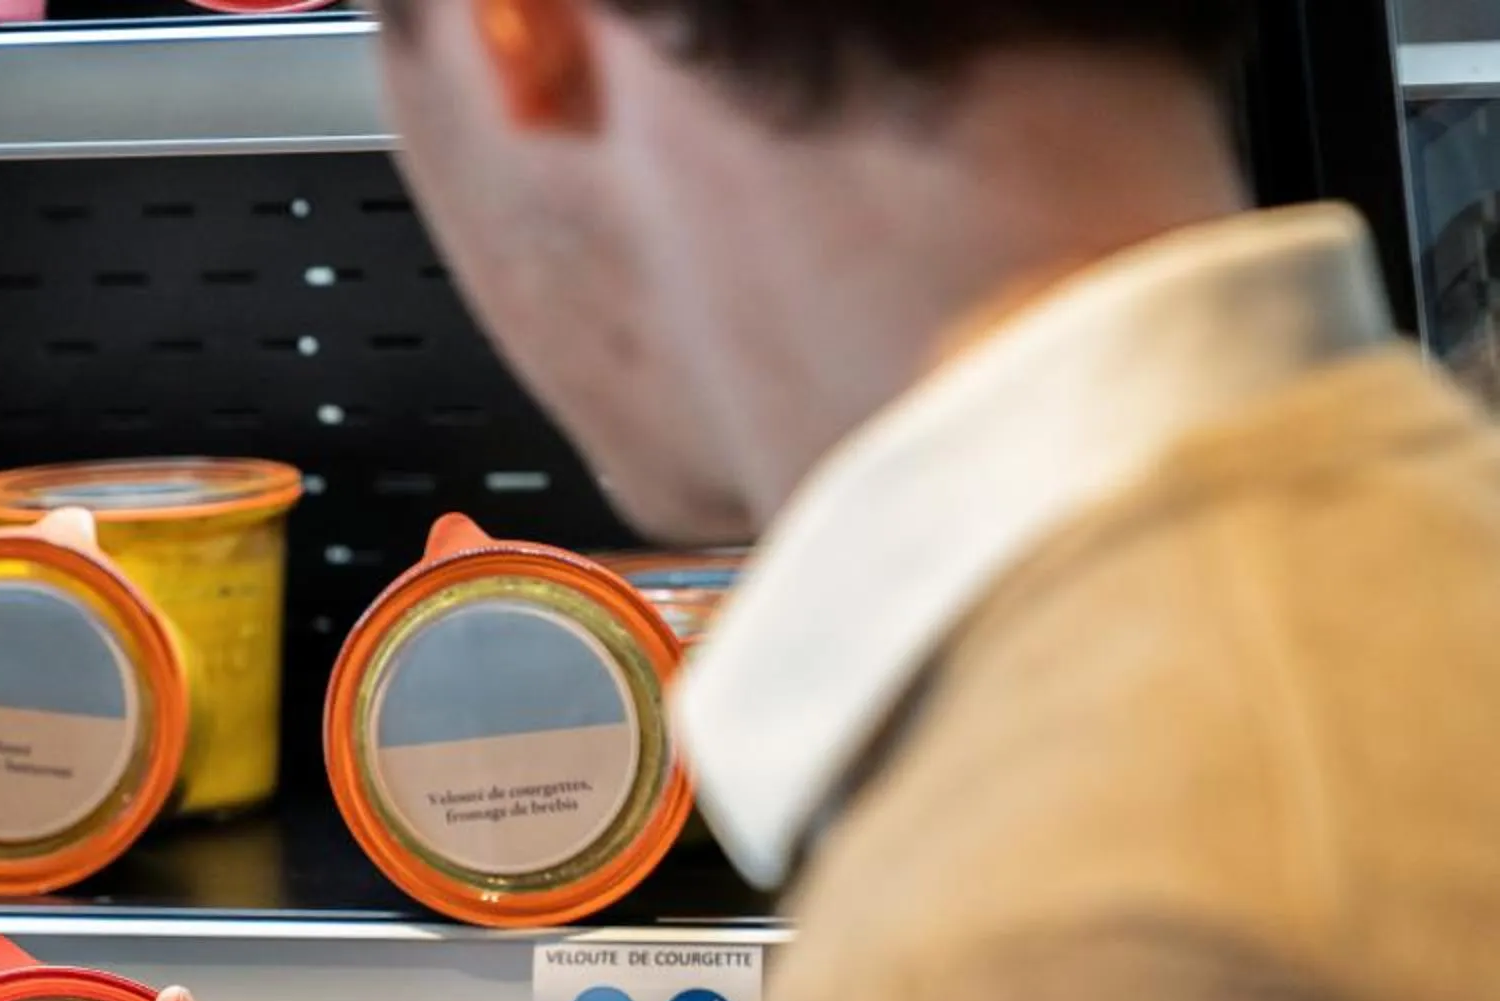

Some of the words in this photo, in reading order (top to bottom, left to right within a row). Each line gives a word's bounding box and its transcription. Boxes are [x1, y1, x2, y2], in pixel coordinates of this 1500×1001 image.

[488, 784, 505, 801] de
[509, 779, 593, 798] courgettes,
[445, 805, 506, 826] fromage
[510, 801, 528, 817] de
[531, 798, 579, 815] brebis
[546, 950, 619, 967] VELOUTE
[628, 950, 650, 967] DE
[654, 951, 753, 968] COURGETTE
